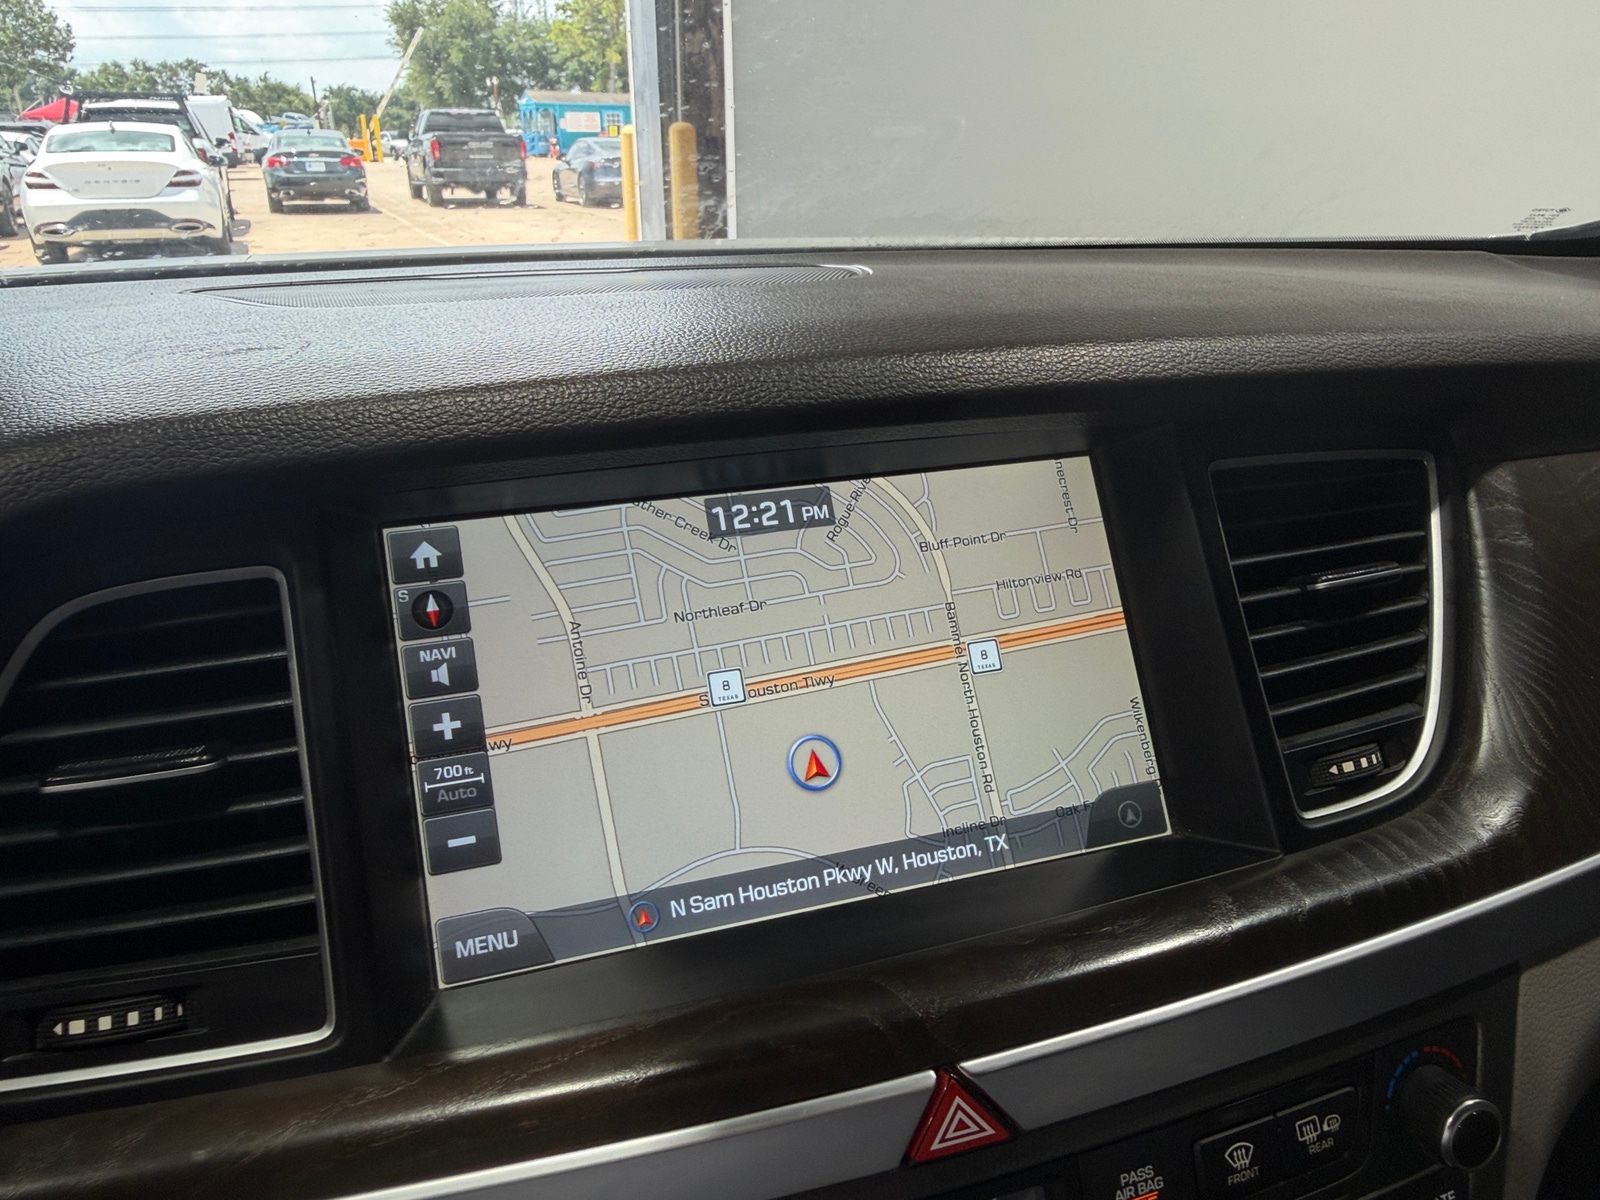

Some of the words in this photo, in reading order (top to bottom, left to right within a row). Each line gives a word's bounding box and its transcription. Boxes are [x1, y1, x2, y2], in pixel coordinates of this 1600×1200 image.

[711, 499, 795, 531] 12:21
[802, 504, 830, 522] PM
[826, 503, 856, 543] Rogue
[1067, 516, 1078, 534] Dr
[674, 516, 714, 545] Creek
[718, 537, 738, 553] Dr
[918, 538, 950, 554] Bluff
[953, 533, 988, 549] Point
[990, 531, 1007, 544] Dr
[995, 571, 1063, 591] Hiltonview
[1065, 568, 1083, 580] Rd
[397, 590, 409, 603] S
[673, 602, 746, 624] Northleaf
[748, 599, 768, 613] Dr
[944, 601, 966, 660] Bammel
[419, 646, 457, 662] NAVI
[568, 620, 589, 681] Antoine
[579, 684, 593, 705] Dr
[979, 650, 989, 661] 8
[977, 662, 996, 670] TEXAS
[721, 680, 731, 691] 8
[748, 681, 799, 699] ouston
[959, 662, 976, 706] North
[718, 694, 739, 702] TEXAS
[487, 738, 512, 752] wy
[967, 708, 989, 771] Houston
[1129, 696, 1157, 776] Wilkenberg
[433, 764, 463, 780] 700
[464, 767, 474, 776] ft
[982, 773, 995, 794] Rd
[437, 786, 478, 803] Auto
[1054, 803, 1081, 818] Oak
[941, 819, 987, 839] Incline
[669, 900, 687, 919] N
[690, 891, 735, 914] Sam
[738, 874, 820, 903] Houston
[823, 864, 873, 887] Pkwy
[874, 855, 899, 876] W,
[902, 839, 983, 871] Houston,
[983, 833, 1010, 853] TX
[455, 929, 519, 959] MENU
[1308, 1137, 1335, 1155] REAR
[1120, 1166, 1155, 1187] PASS
[1227, 1165, 1261, 1186] FRONT
[1115, 1186, 1136, 1200] AIR
[1137, 1176, 1165, 1196] BAG
